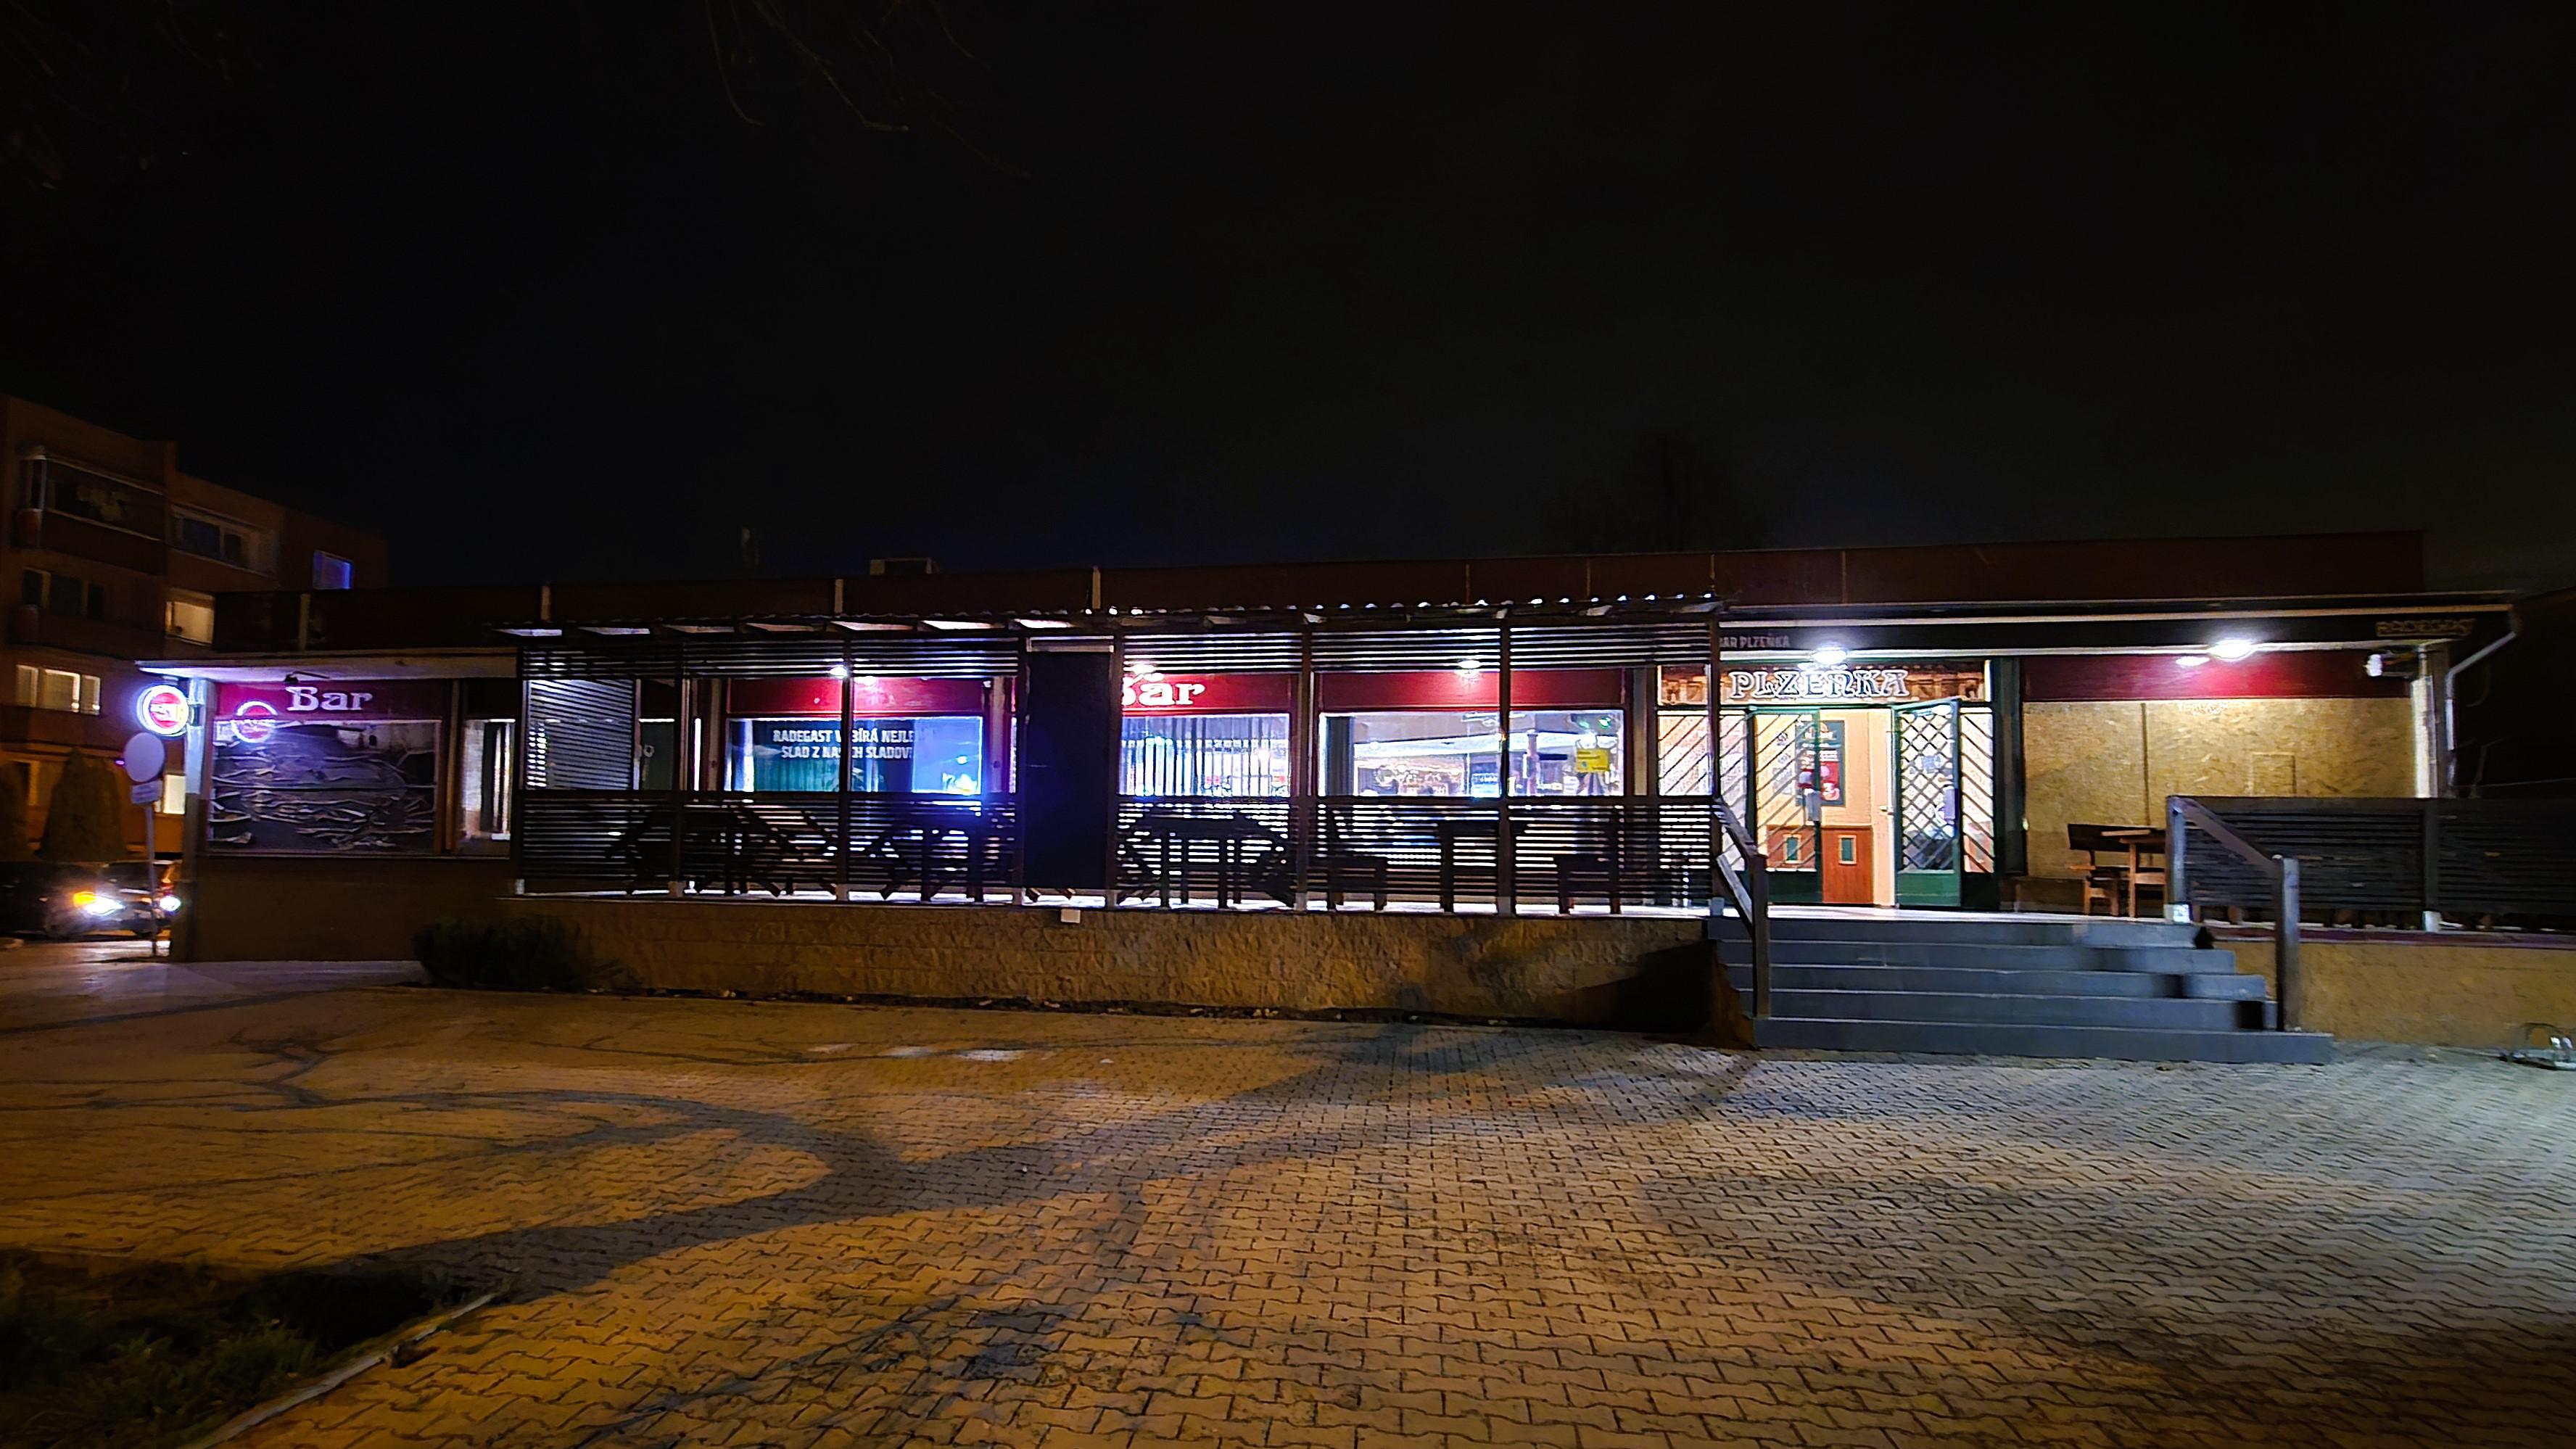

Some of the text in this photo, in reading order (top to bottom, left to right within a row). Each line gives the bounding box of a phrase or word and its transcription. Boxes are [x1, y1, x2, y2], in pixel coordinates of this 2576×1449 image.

[285, 686, 373, 711] Bar
[772, 730, 833, 743] RADEGAST
[835, 727, 878, 743] VBÍRÁ
[781, 746, 810, 759] SLAD
[812, 746, 820, 759] Z
